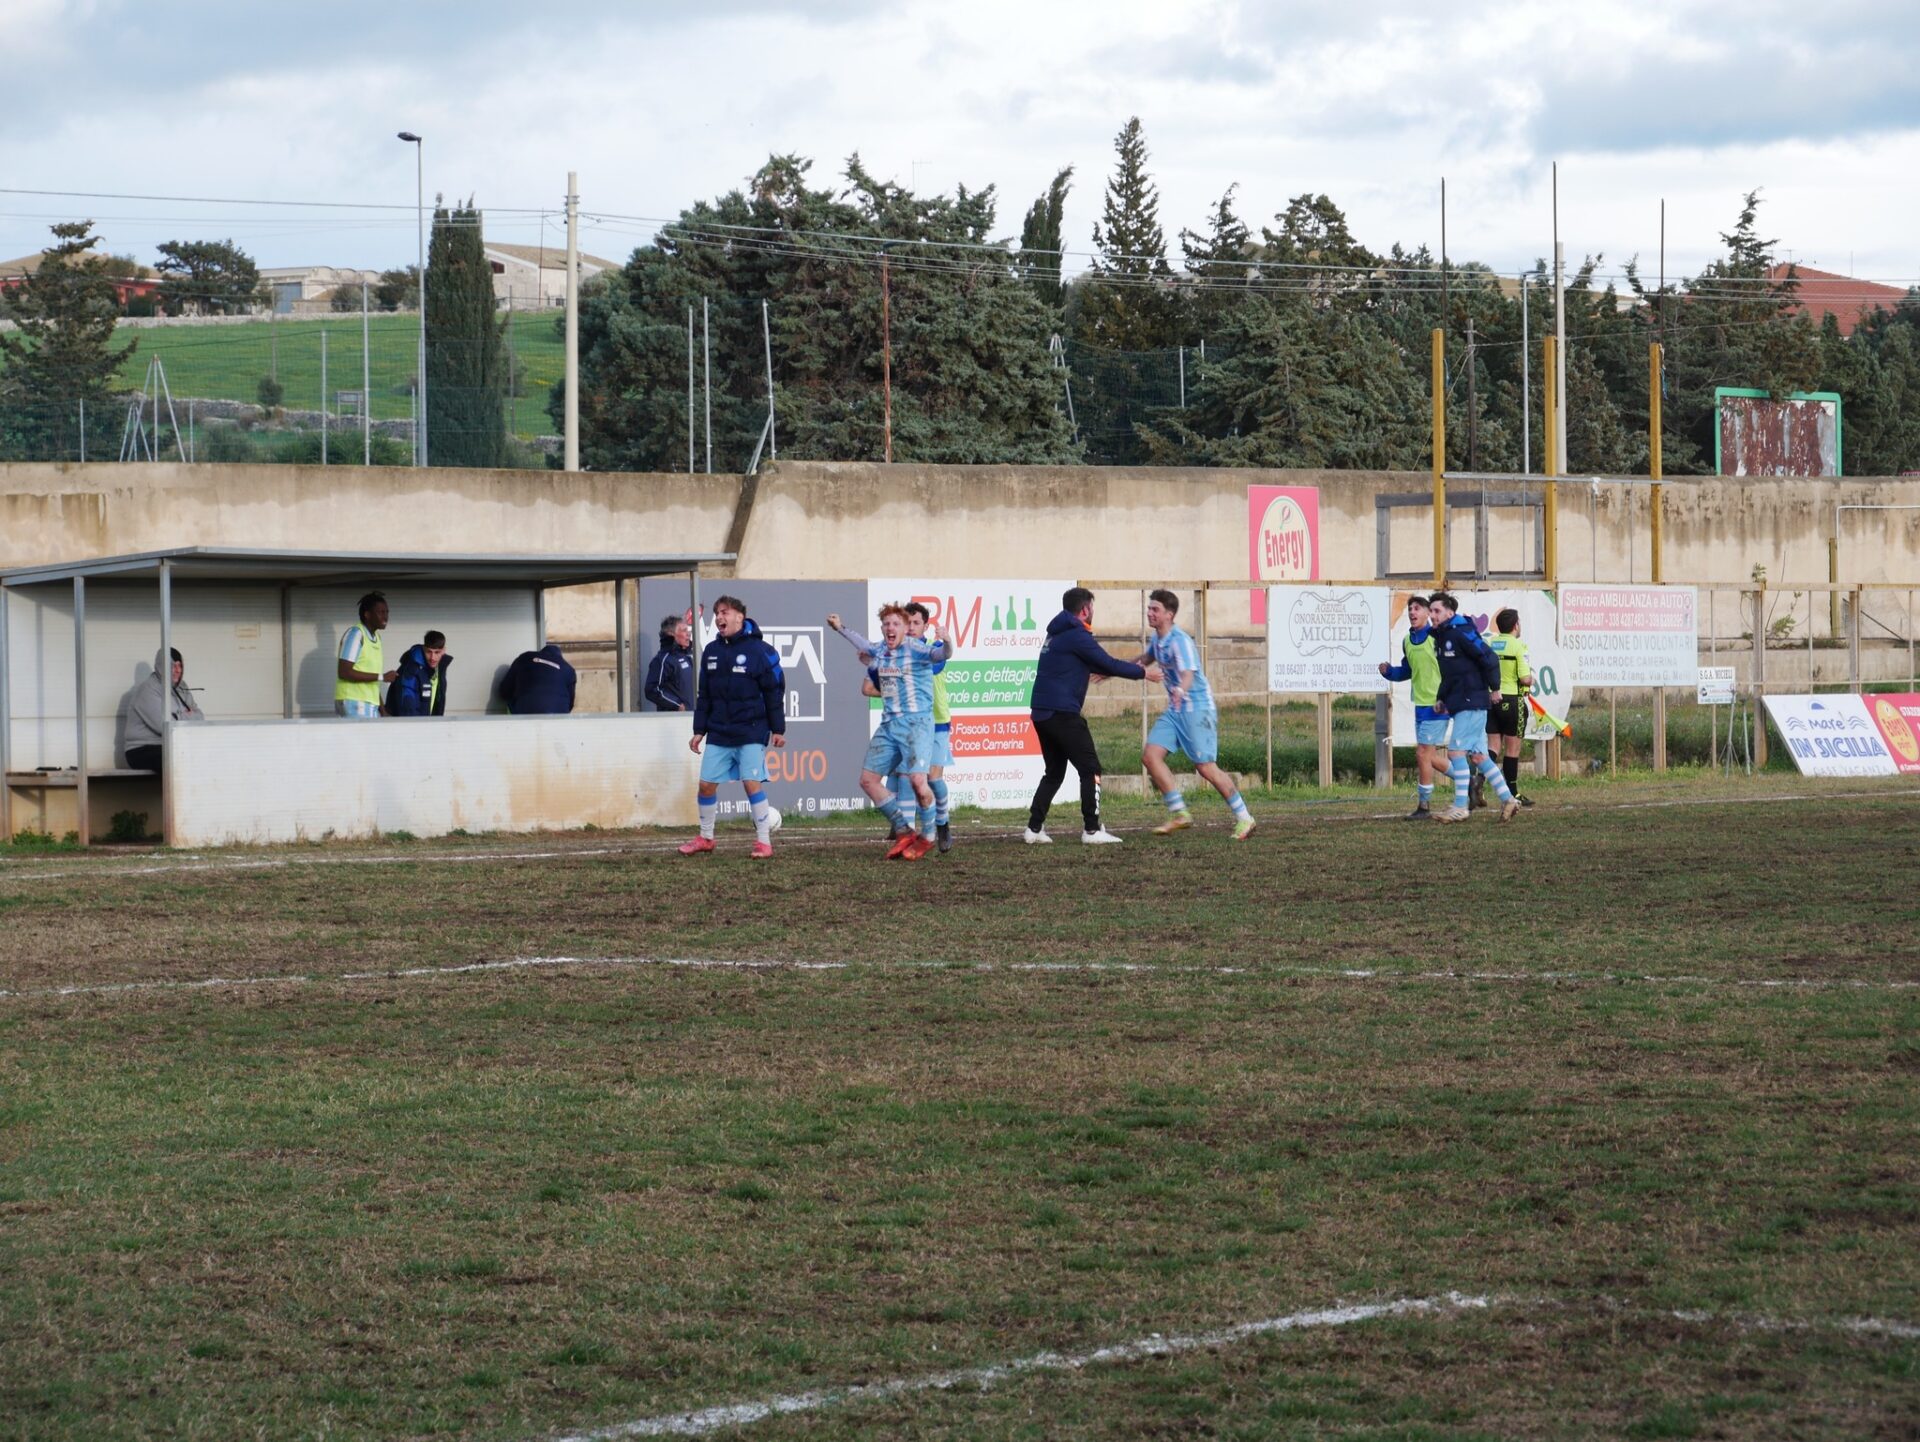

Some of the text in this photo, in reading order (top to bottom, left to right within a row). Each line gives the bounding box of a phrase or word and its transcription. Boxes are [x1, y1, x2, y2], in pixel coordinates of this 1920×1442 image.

[1265, 530, 1304, 569] Energy
[1565, 592, 1599, 607] Servizio
[1599, 592, 1652, 608] AMBULANZA
[1314, 604, 1346, 613] AGENZIA
[1294, 613, 1369, 625] ONORANZE FUNEBRI
[1300, 626, 1364, 641] MICIELI
[983, 635, 1008, 647] cash
[1010, 635, 1017, 646] &
[1020, 636, 1043, 649] carry
[1562, 634, 1693, 650] ASSOCIAZIONE DI VOLONTARI
[1578, 655, 1678, 667] SANTA CROCE CAMERINA
[972, 670, 981, 683] e
[983, 666, 1037, 685] dettaglio
[1274, 680, 1283, 689] Via
[1329, 680, 1346, 689] Croce
[972, 691, 980, 703] e
[982, 687, 1025, 703] alimenti
[955, 722, 990, 735] Foscolo
[992, 721, 1030, 736] 13,15,17
[954, 739, 981, 751] Croce
[982, 738, 1024, 750] Camerina
[1789, 737, 1888, 758] IN SICILIA
[975, 773, 983, 781] a
[984, 769, 1024, 781] domicilio
[991, 789, 1011, 800] 0932
[720, 800, 731, 814] 119
[819, 797, 864, 812] MACCASRL.COM
